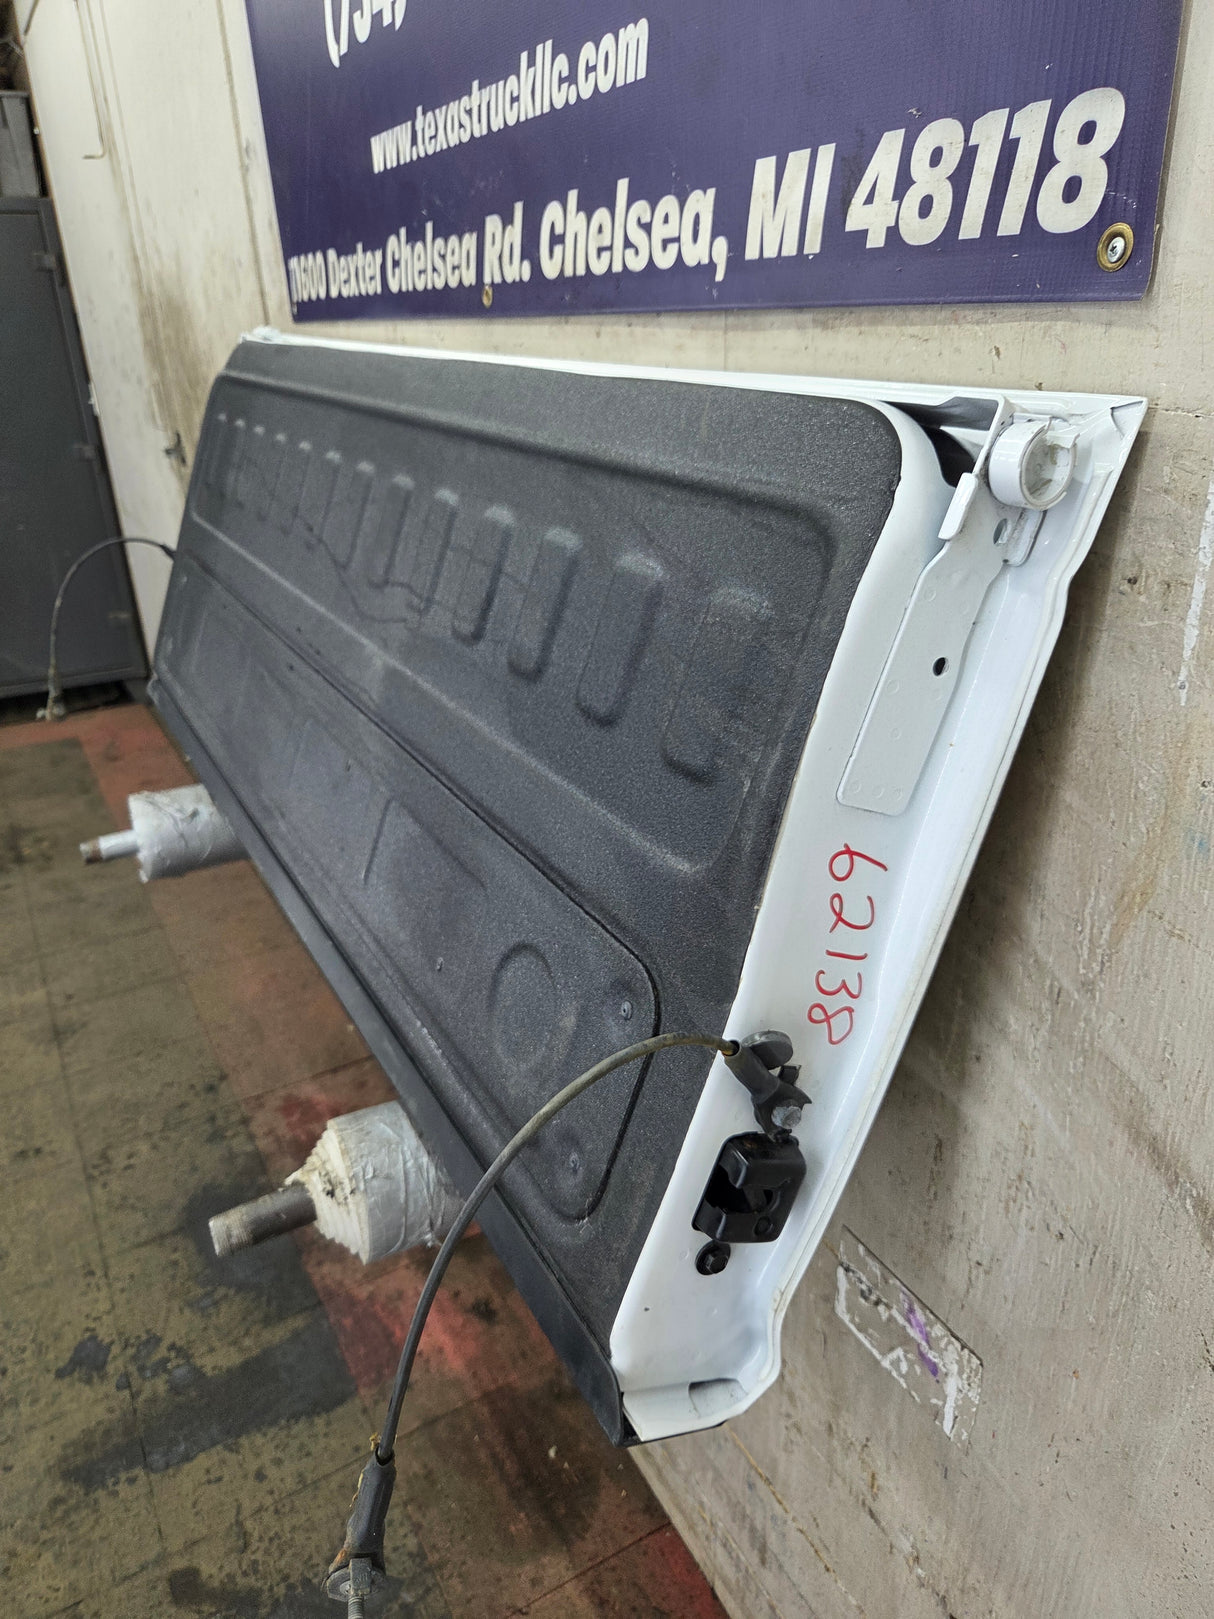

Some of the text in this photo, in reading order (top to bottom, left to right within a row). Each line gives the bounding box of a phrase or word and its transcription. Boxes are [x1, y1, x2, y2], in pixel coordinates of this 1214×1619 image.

[326, 242, 383, 298] Dexter
[386, 221, 477, 294] Chelsea
[484, 202, 531, 284] Rd.
[540, 178, 728, 281] Chelsea,
[745, 143, 836, 261] MI
[845, 87, 1125, 248] 48118
[370, 18, 648, 174] www.texastruckllc.com
[807, 843, 888, 1045] 62138
